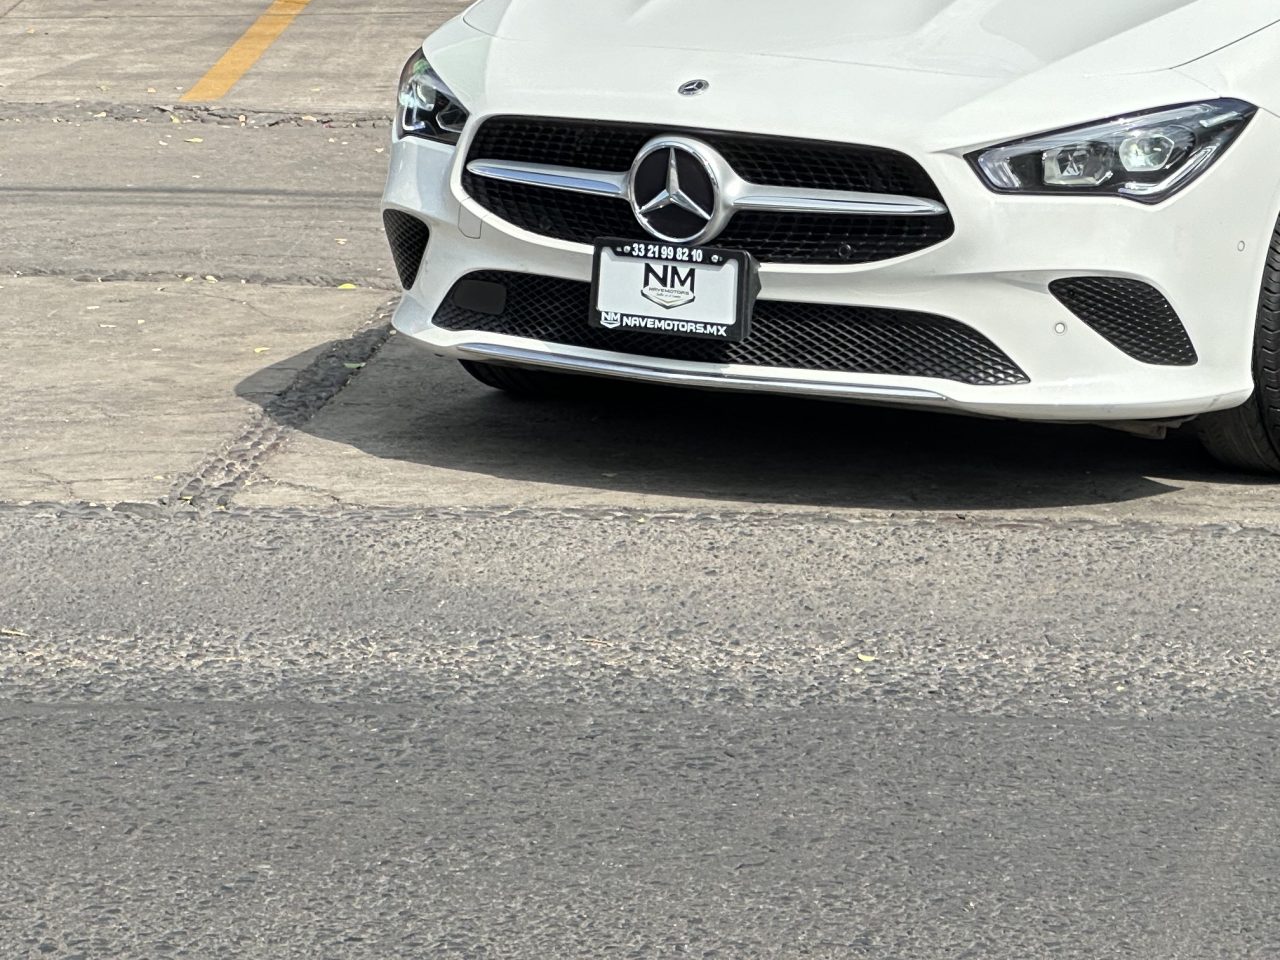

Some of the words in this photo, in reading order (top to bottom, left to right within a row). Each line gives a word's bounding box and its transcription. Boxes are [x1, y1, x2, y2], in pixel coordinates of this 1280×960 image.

[632, 242, 645, 257] 33
[647, 244, 659, 258] 21
[661, 245, 675, 260] 99
[676, 247, 689, 261] 82
[691, 249, 703, 262] 10
[644, 262, 696, 294] NM
[622, 316, 727, 337] NAVEMOTORS.MX
